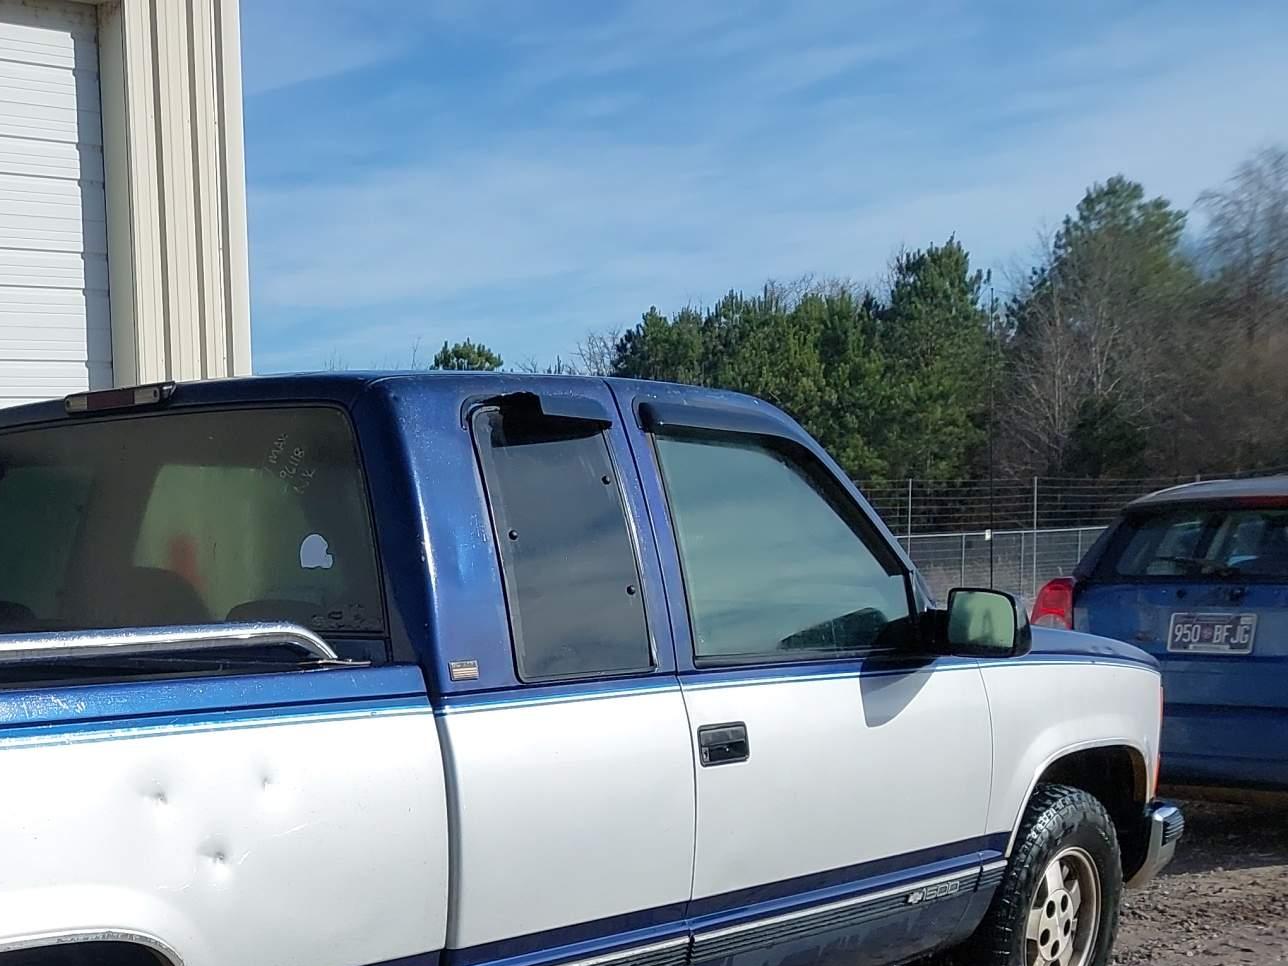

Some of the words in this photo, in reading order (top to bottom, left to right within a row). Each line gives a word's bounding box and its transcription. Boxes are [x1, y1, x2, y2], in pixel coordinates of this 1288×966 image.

[1174, 624, 1201, 642] 950
[1212, 624, 1250, 644] BFJG
[922, 880, 960, 901] 1500
